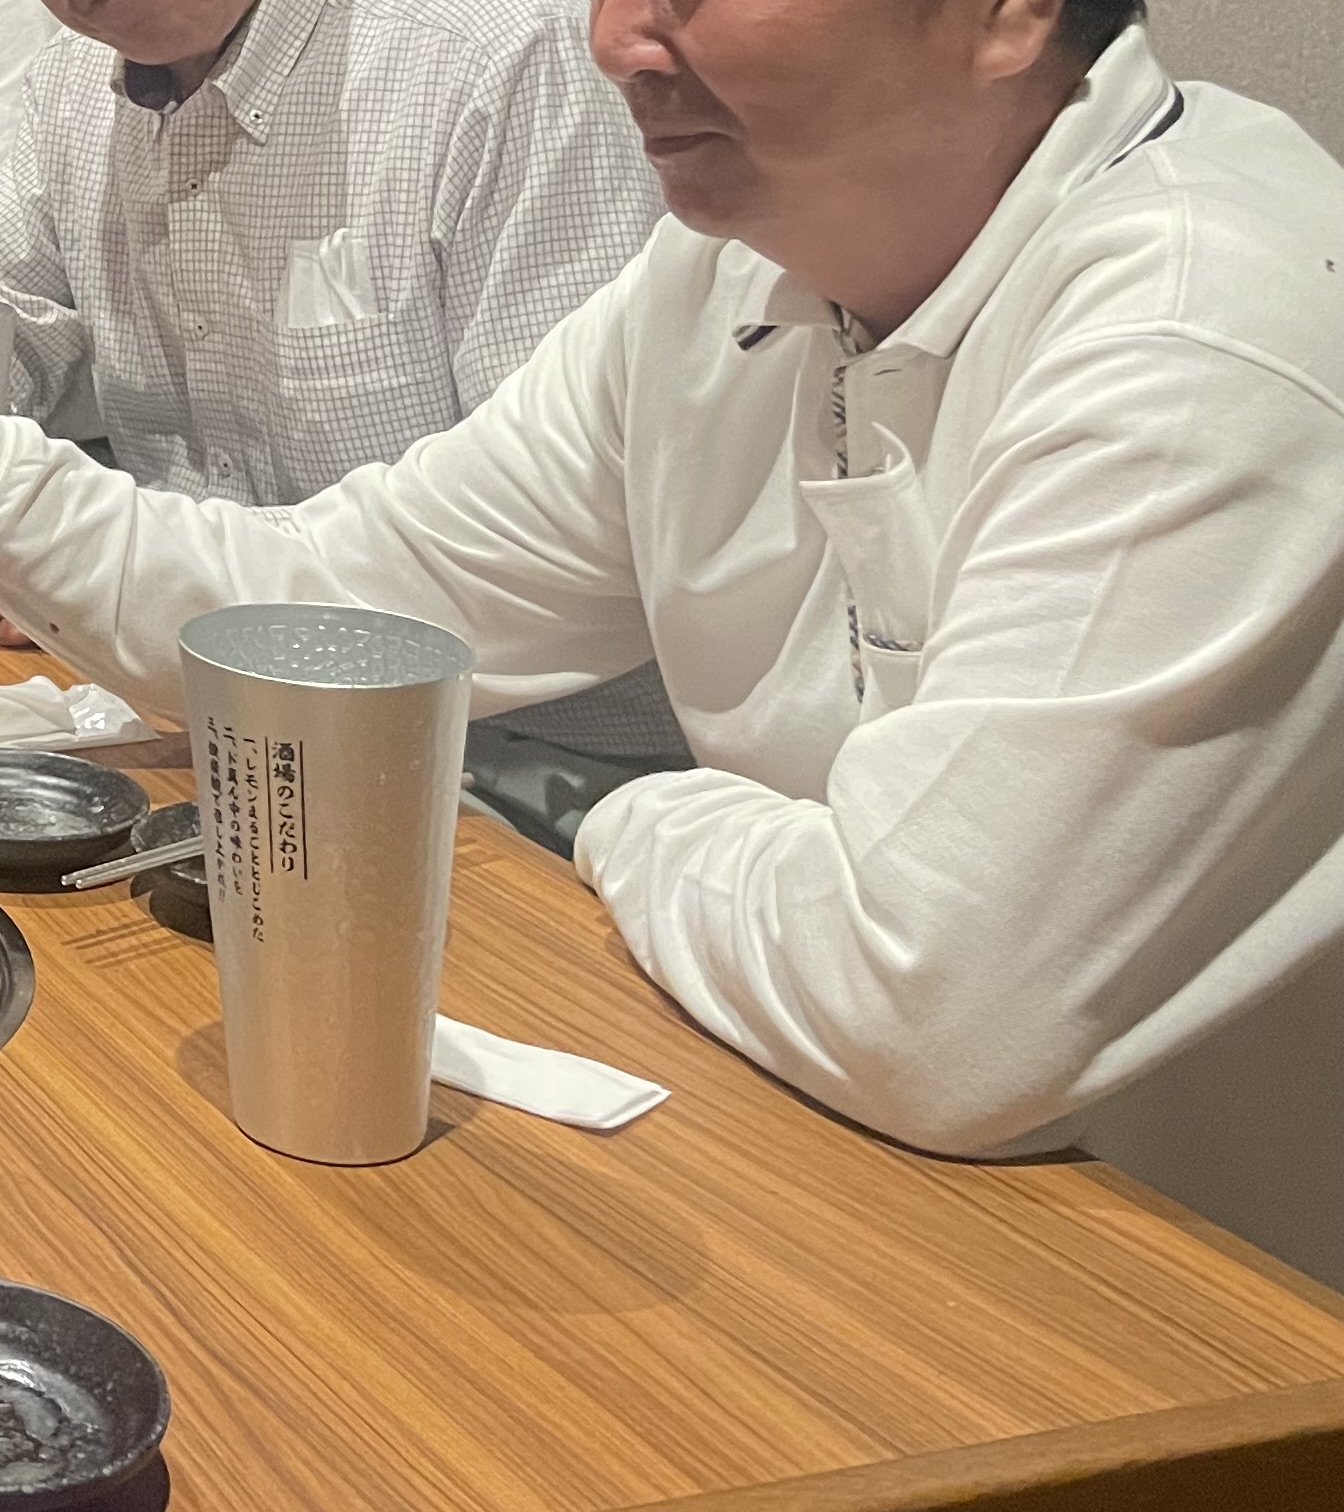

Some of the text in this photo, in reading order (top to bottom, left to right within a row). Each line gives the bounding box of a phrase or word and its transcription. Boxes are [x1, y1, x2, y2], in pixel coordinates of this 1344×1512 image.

[272, 741, 298, 872] 酒場のこだわり
